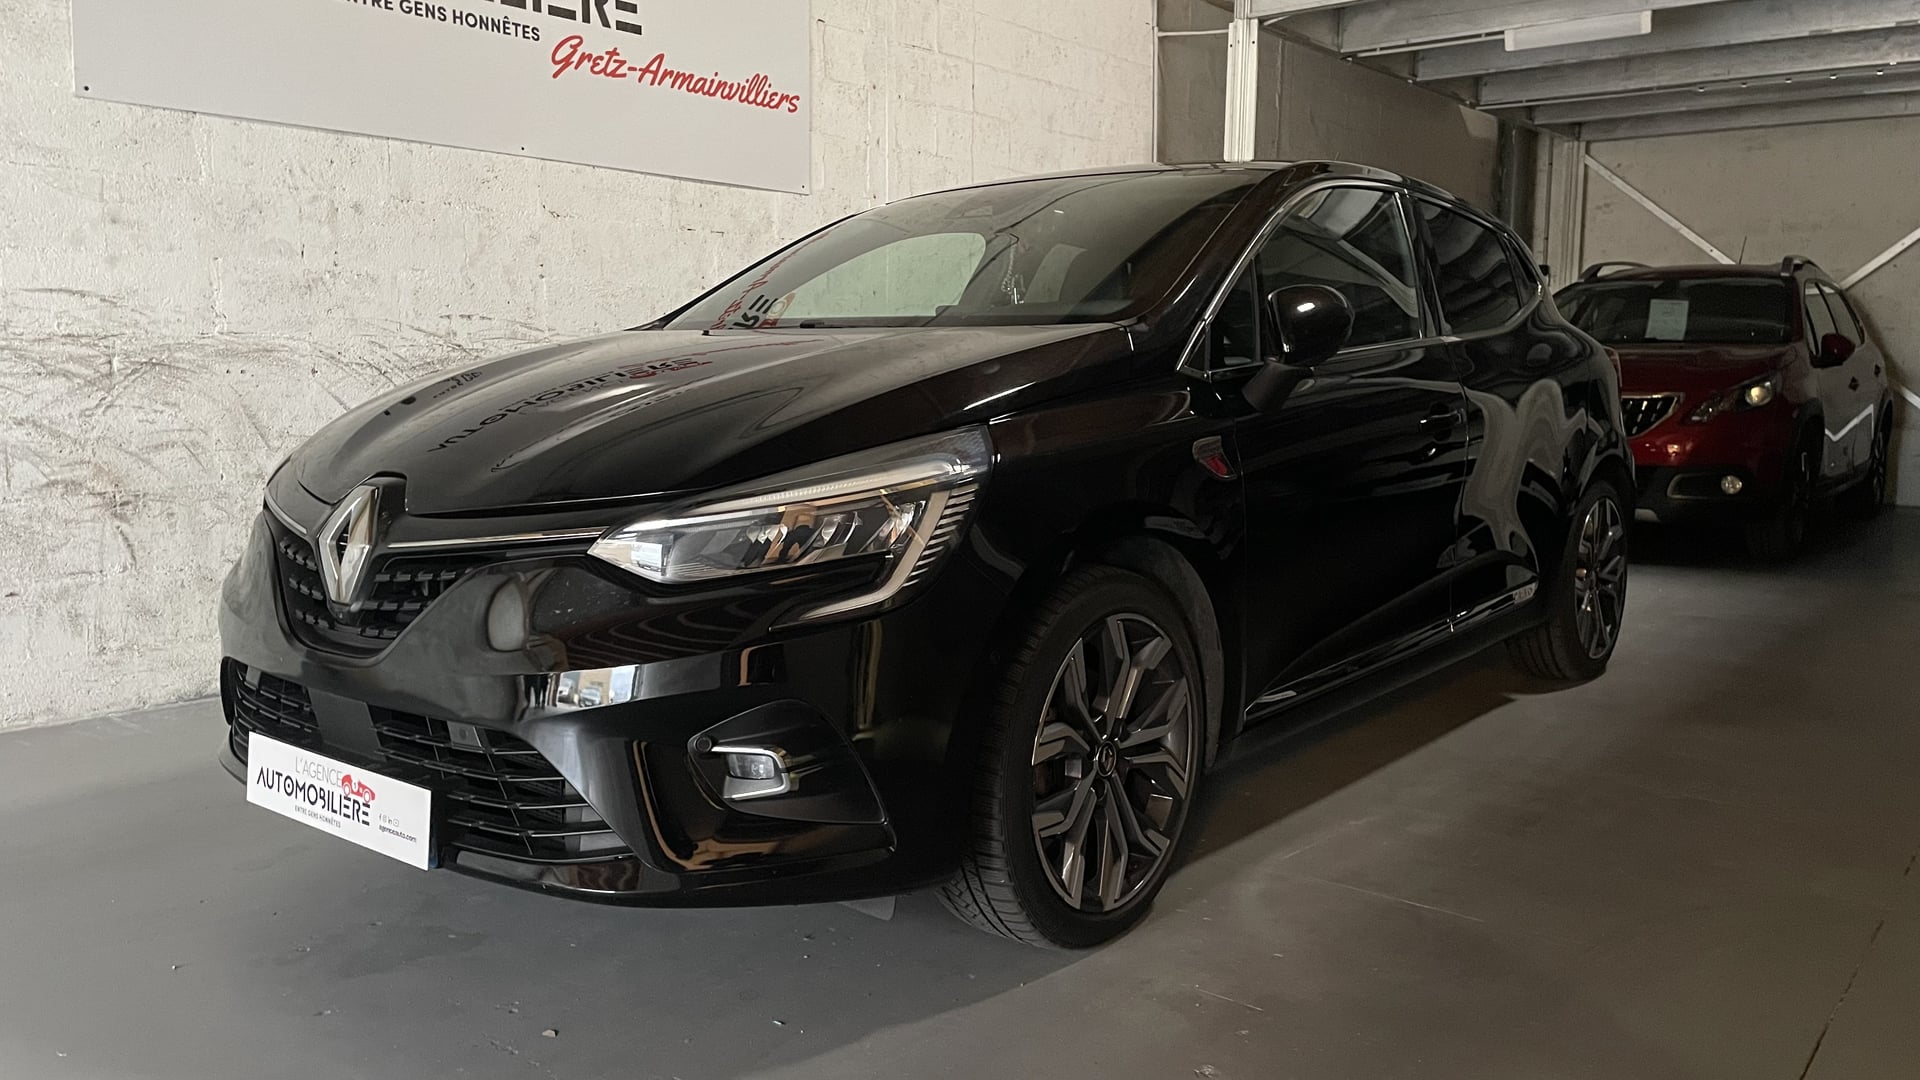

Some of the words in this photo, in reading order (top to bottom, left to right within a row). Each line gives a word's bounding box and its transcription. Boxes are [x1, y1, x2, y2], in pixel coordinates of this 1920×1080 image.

[400, 0, 447, 22] GENS
[452, 9, 540, 42] HONNÊTES
[551, 34, 800, 113] Gretz-Armainvilliers
[295, 756, 342, 788] L'AGENCE
